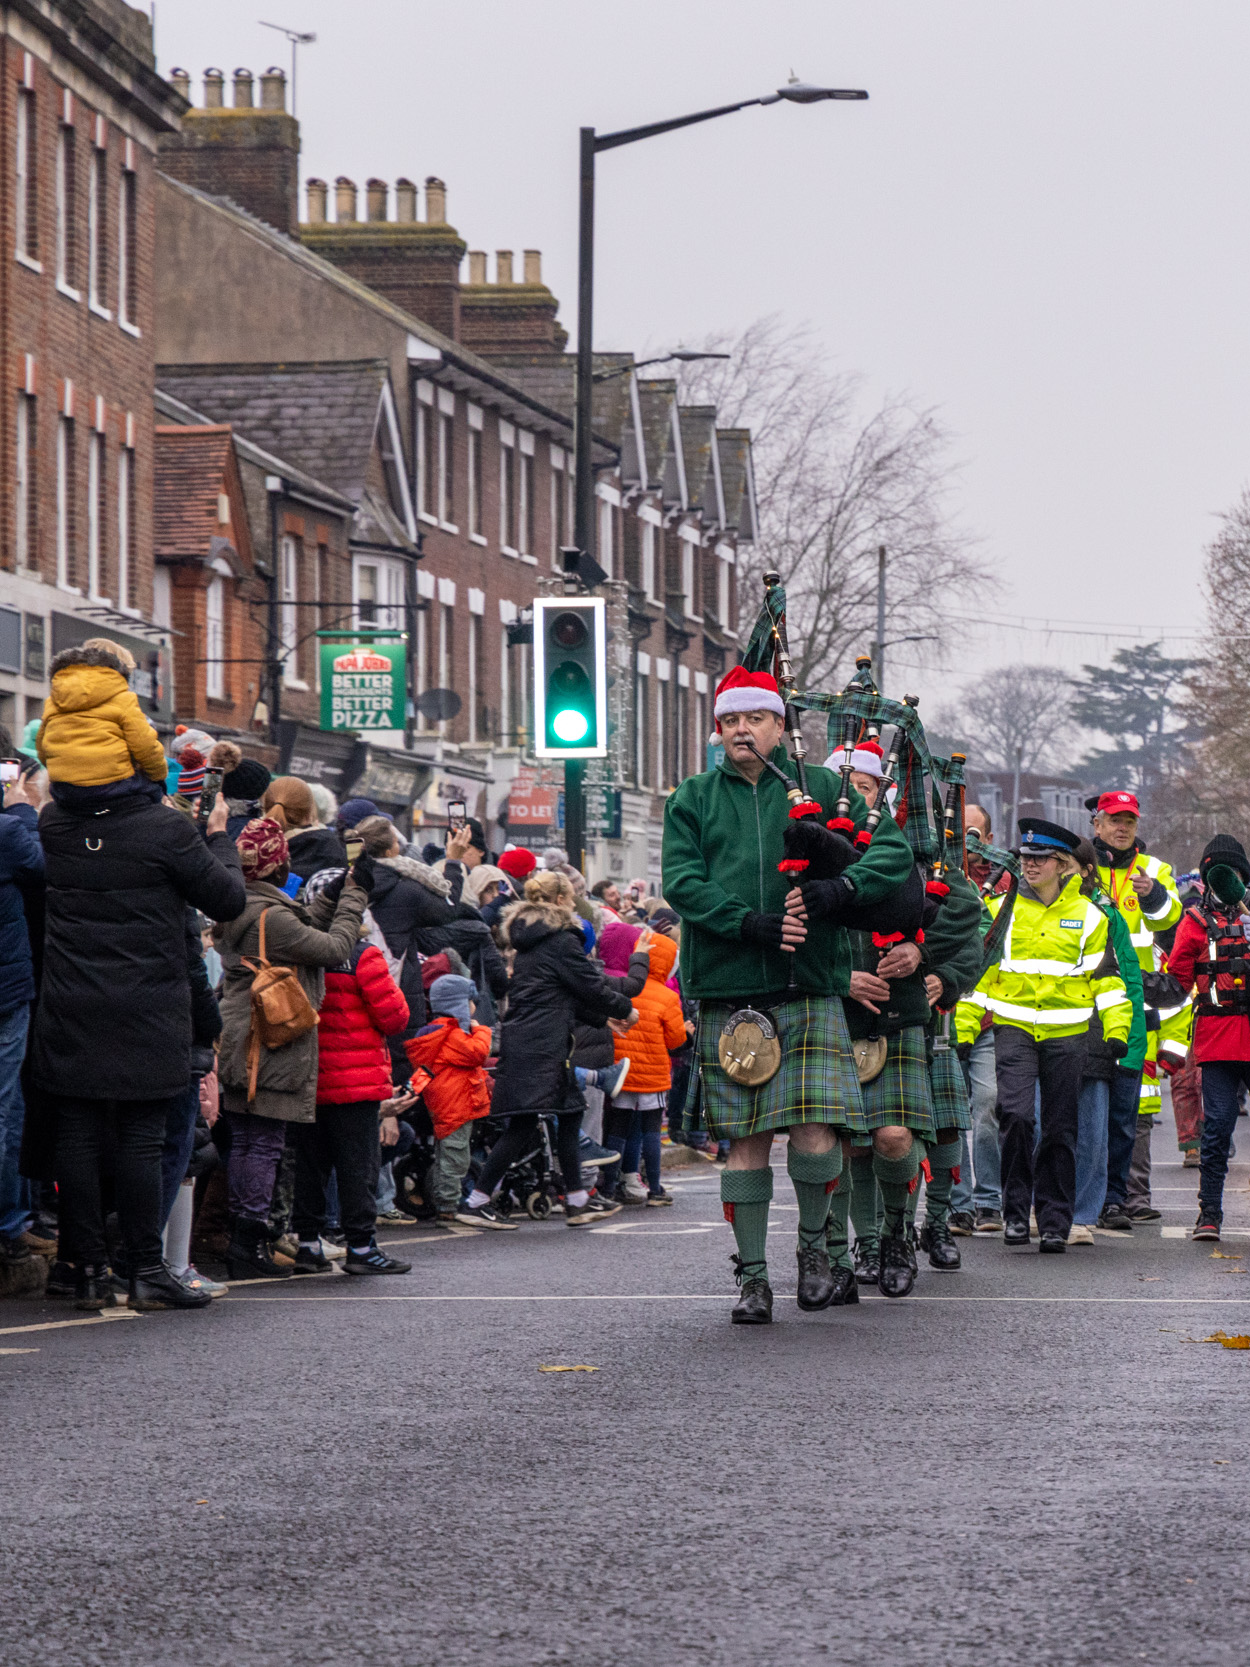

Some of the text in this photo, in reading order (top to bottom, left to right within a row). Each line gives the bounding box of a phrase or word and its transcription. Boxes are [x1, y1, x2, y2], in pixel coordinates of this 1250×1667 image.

[332, 674, 393, 689] BETTER
[332, 697, 393, 710] BETTER
[332, 711, 393, 728] PIZZA
[510, 804, 552, 818] TO LET
[1060, 920, 1082, 928] CADET
